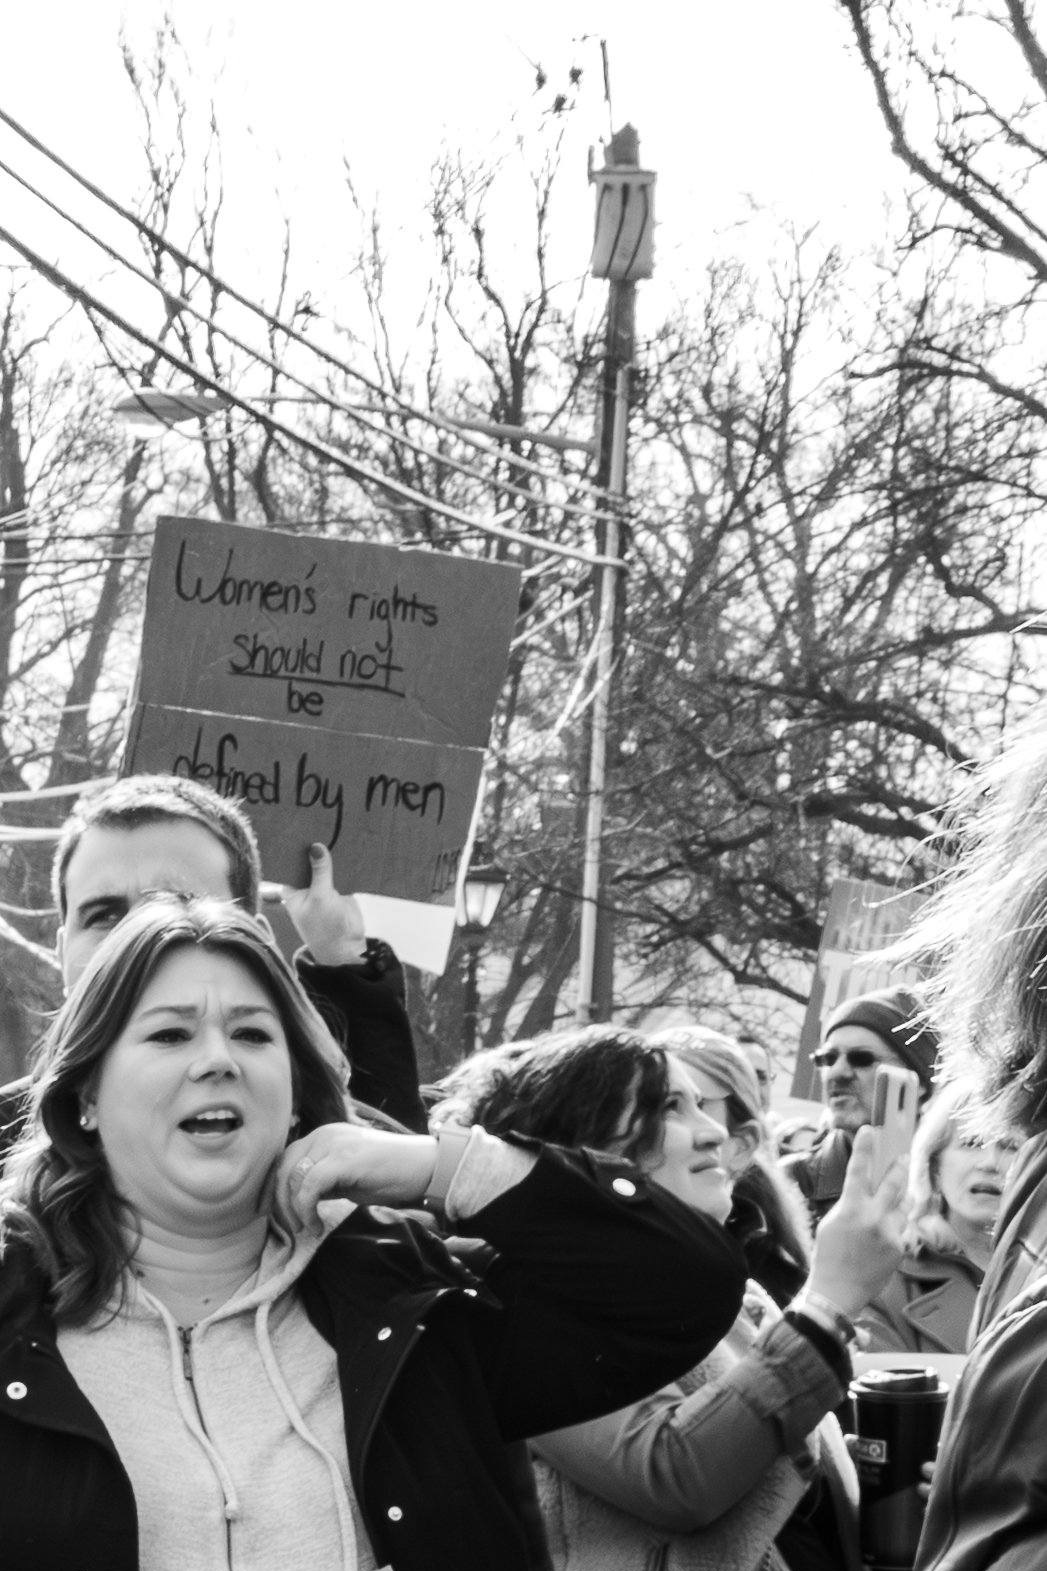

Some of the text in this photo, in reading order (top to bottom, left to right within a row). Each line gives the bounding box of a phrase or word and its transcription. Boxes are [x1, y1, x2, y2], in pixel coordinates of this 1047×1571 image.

[174, 540, 440, 653] Women's rights
[287, 680, 326, 717] be
[339, 646, 405, 690] not
[295, 752, 345, 851] by
[364, 773, 447, 826] men
